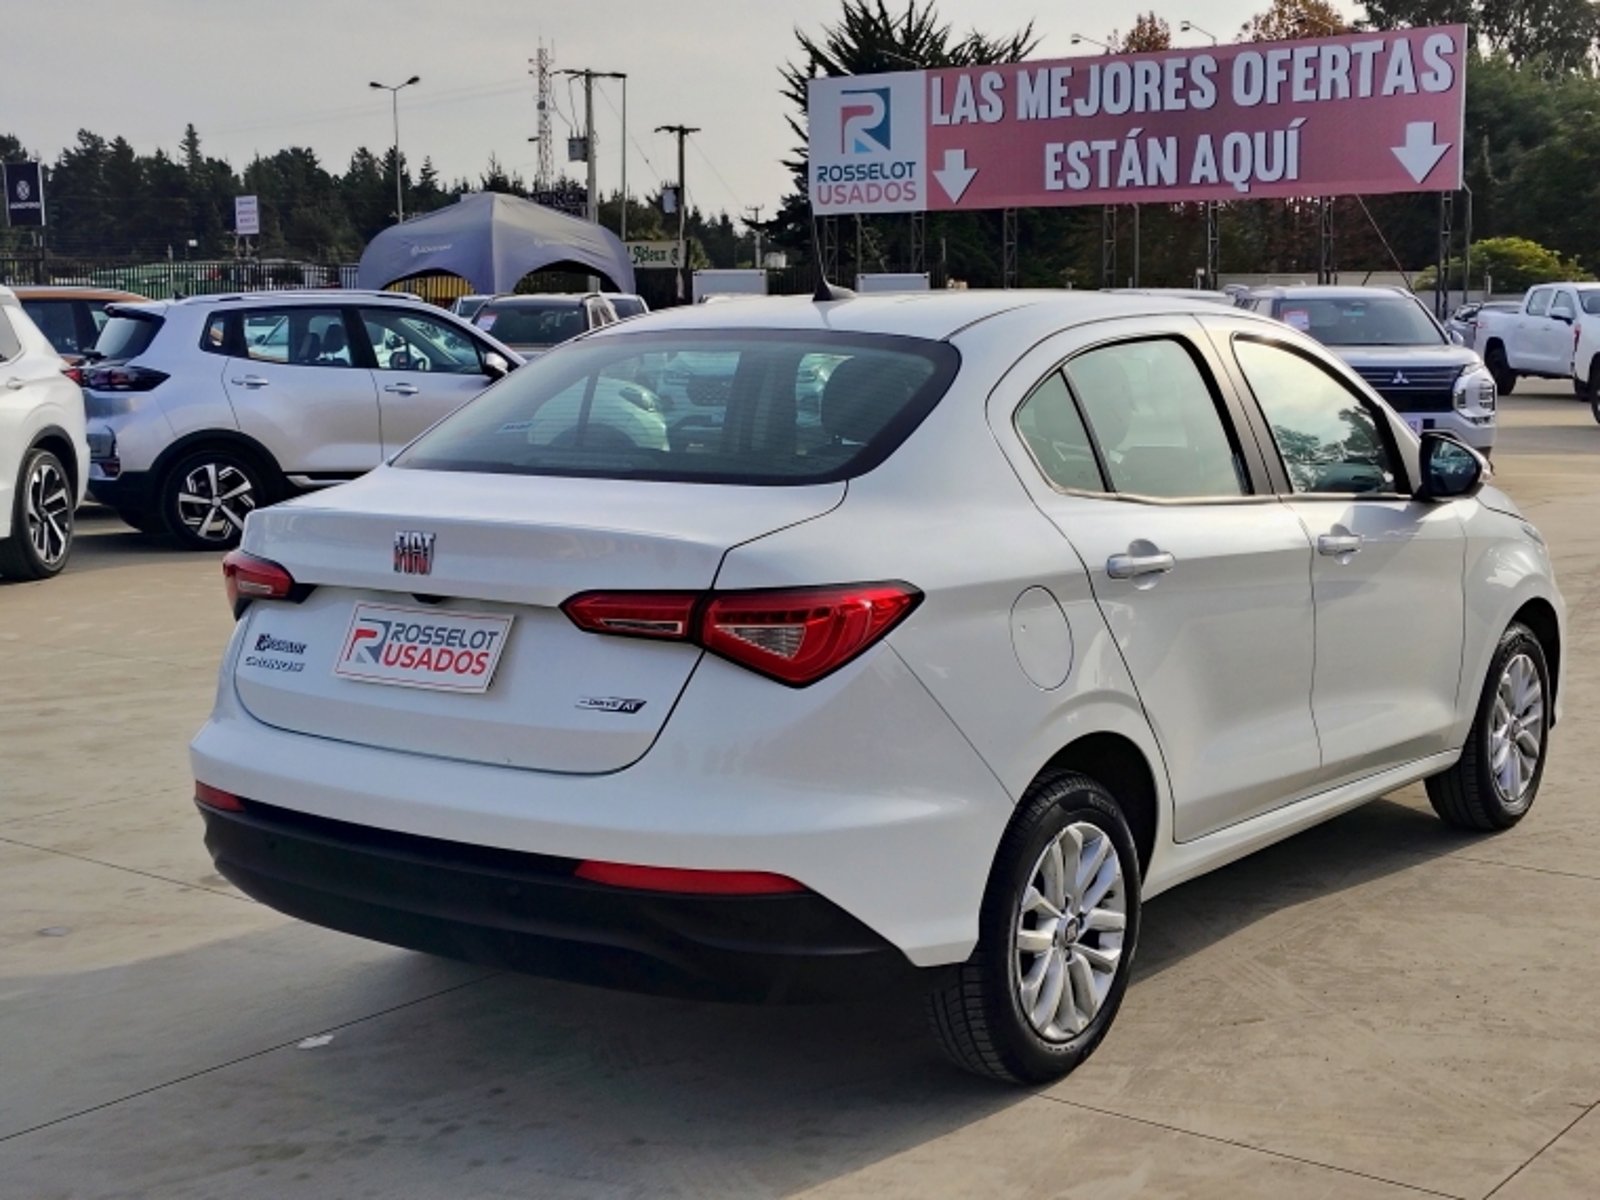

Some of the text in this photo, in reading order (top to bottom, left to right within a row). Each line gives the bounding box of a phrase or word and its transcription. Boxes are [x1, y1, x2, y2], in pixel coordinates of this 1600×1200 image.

[931, 32, 1457, 126] LAS MEJORES OFERTAS
[1044, 117, 1308, 193] ESTÁN AQUÍ
[816, 161, 916, 183] ROSSELOT
[817, 181, 917, 205] USADOS
[394, 531, 437, 576] FIAT
[391, 622, 499, 650] ROSSELOT
[382, 643, 489, 676] USADOS
